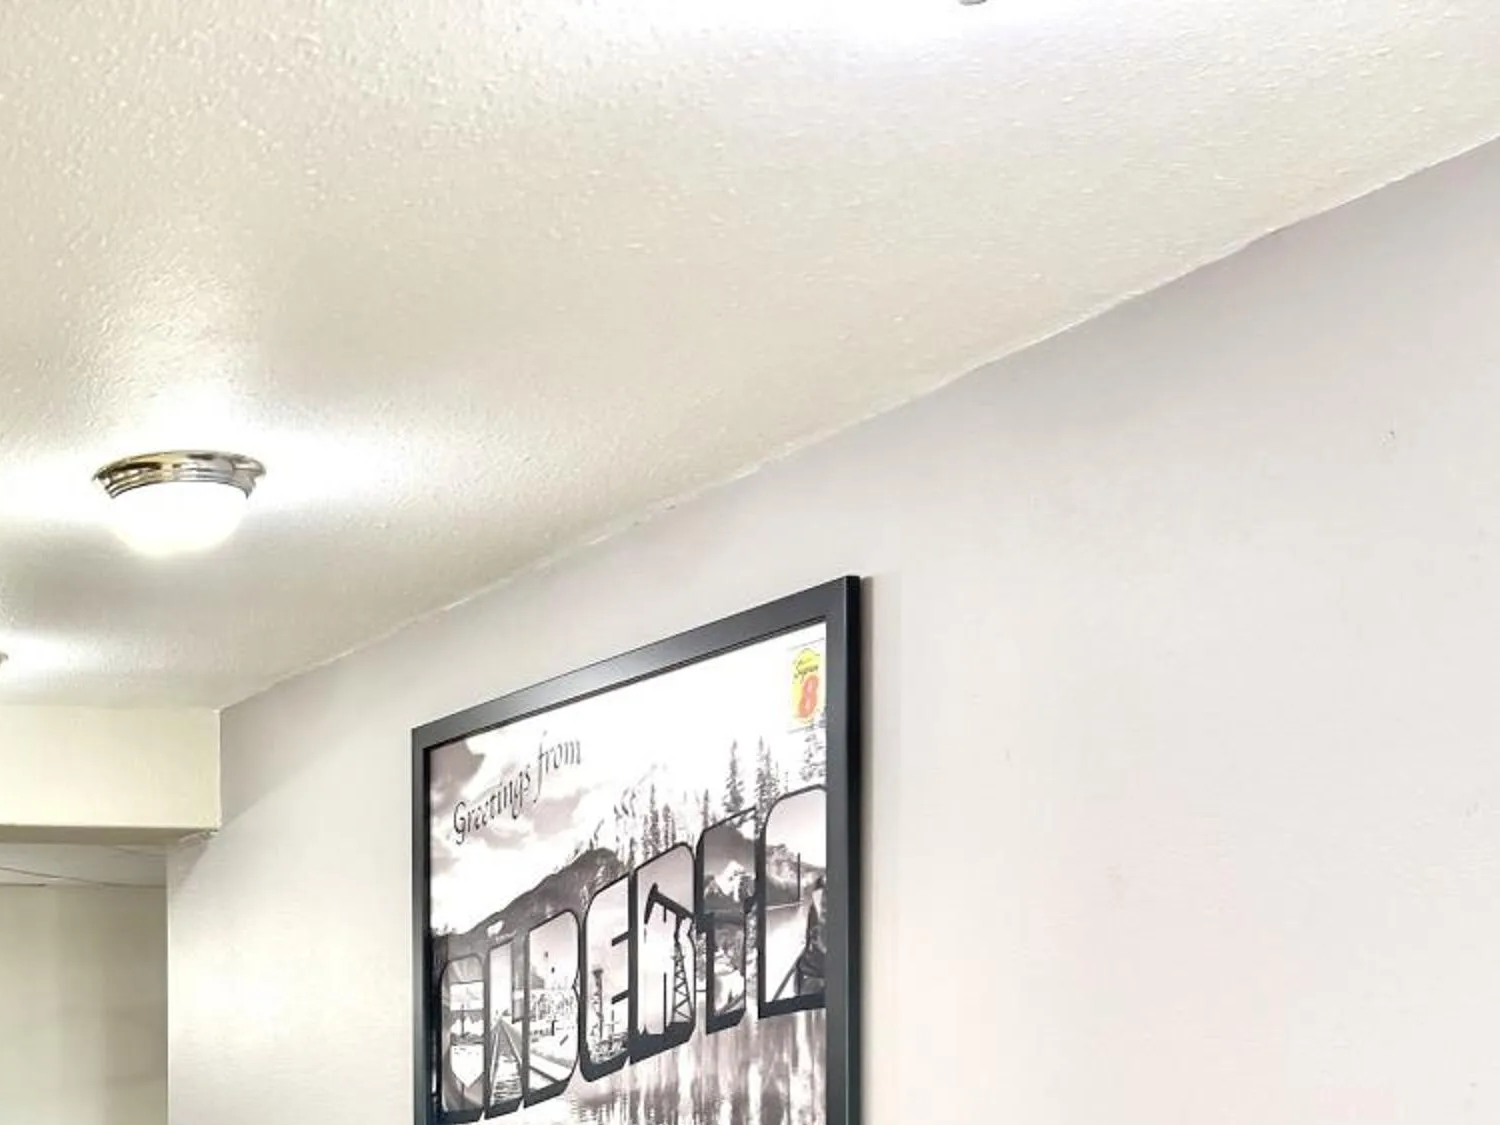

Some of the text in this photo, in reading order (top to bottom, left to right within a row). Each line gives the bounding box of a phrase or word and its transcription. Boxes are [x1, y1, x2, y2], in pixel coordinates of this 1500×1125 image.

[797, 674, 820, 718] 8
[453, 730, 581, 845] Greetings from
